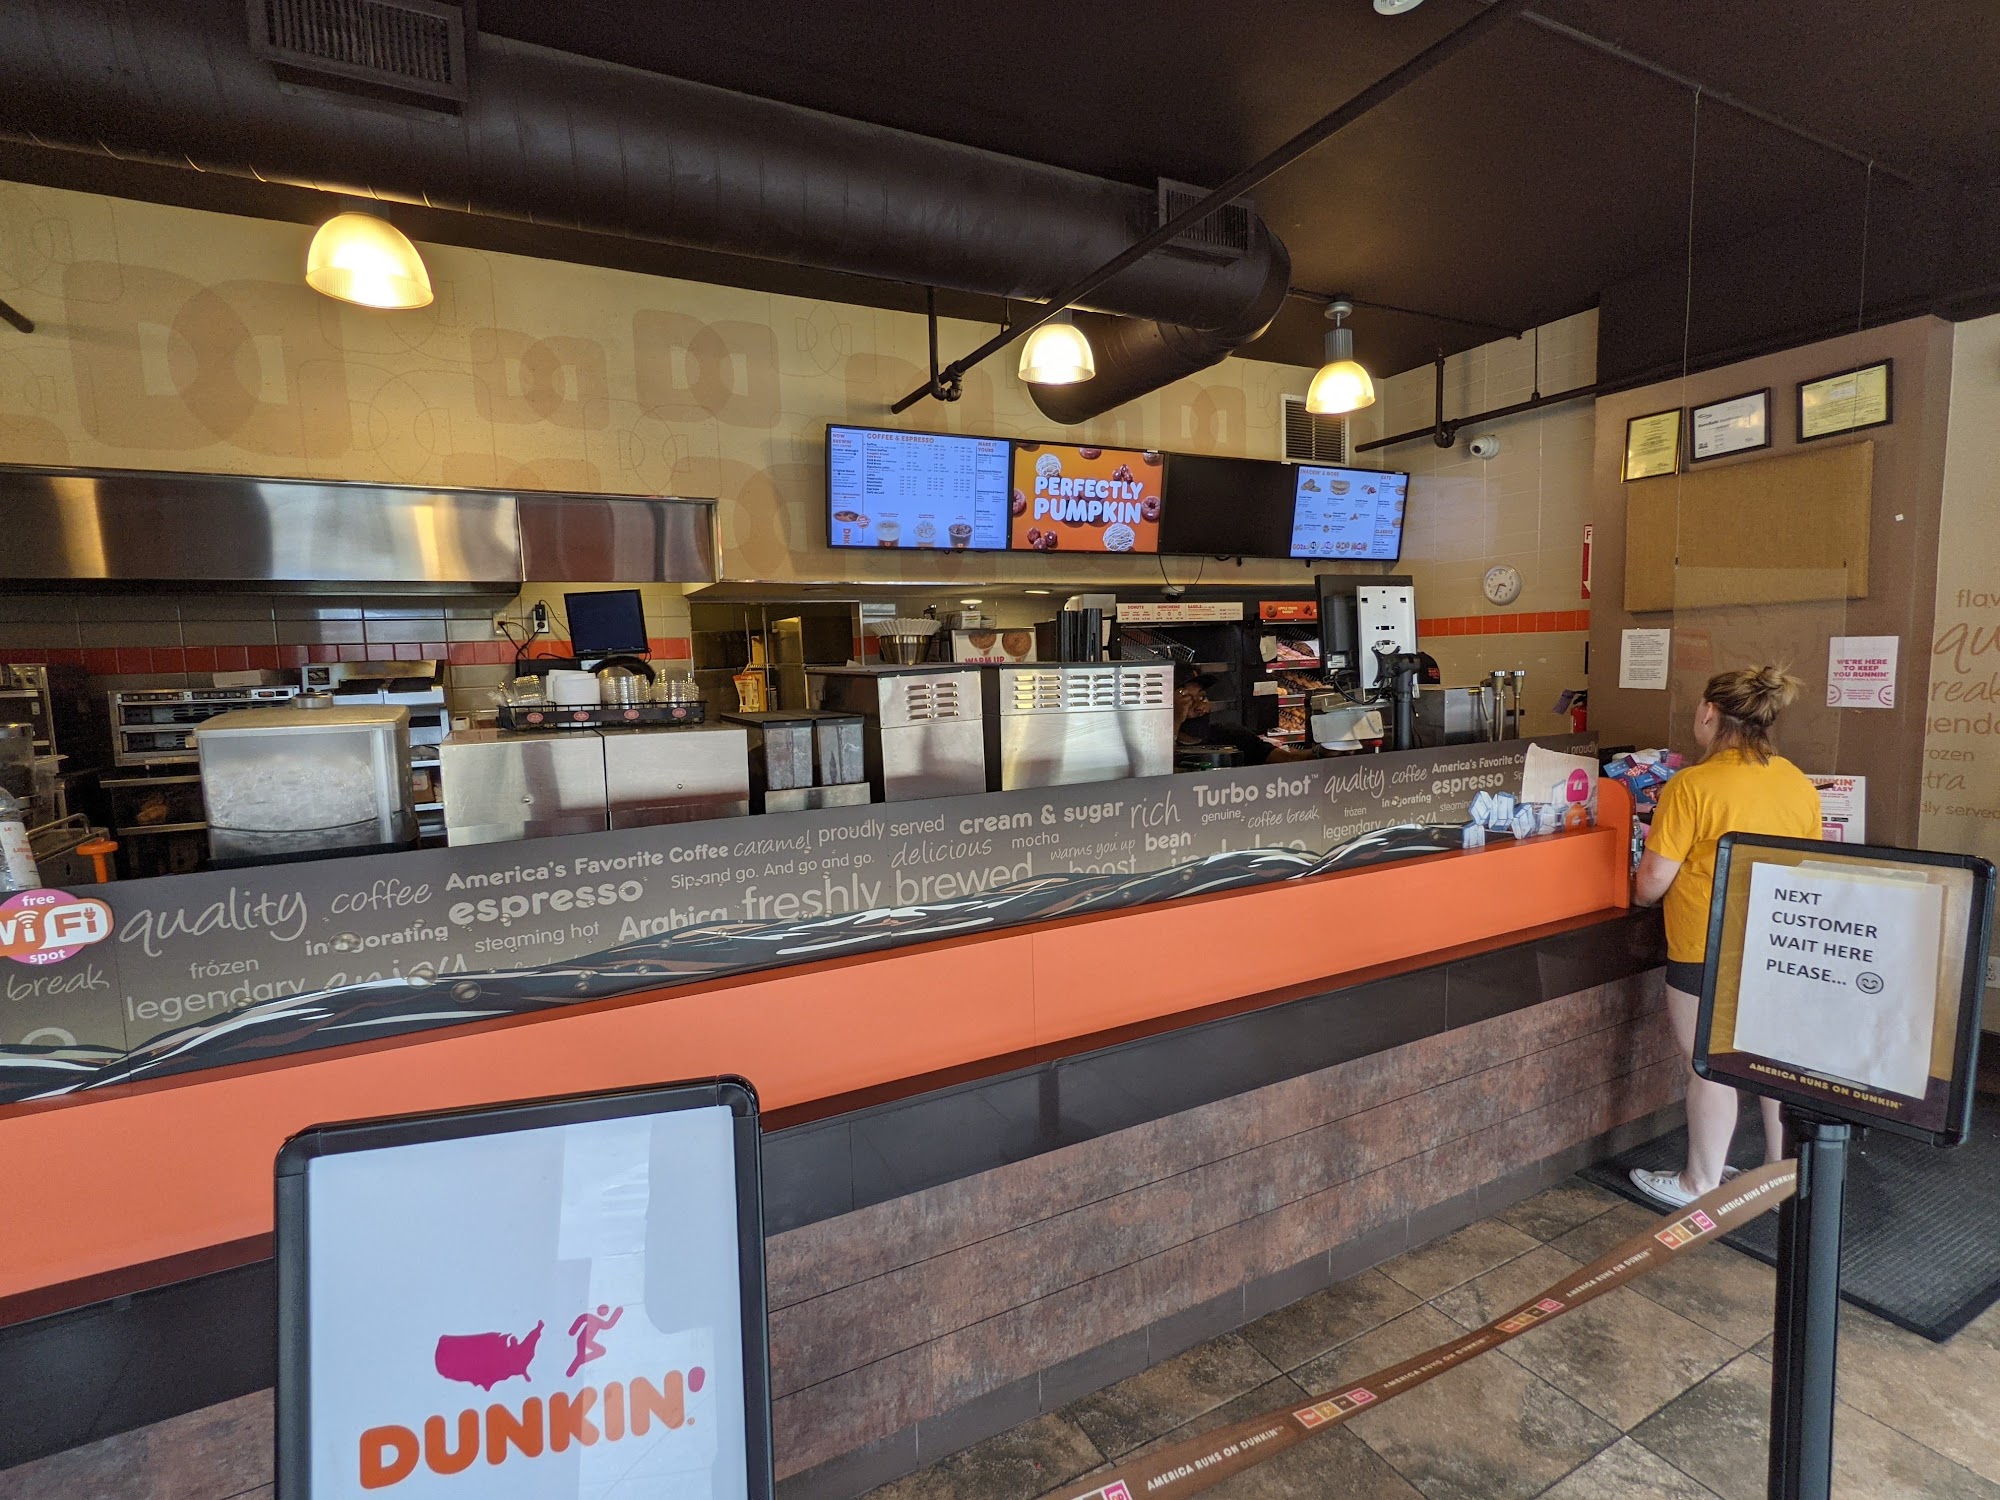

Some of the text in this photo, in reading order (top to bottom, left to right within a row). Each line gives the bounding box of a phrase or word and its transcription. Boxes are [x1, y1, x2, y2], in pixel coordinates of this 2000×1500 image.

[866, 433, 894, 441] COFFEE
[901, 435, 935, 444] ESPRESSO
[1035, 476, 1144, 500] PERFECTLY
[1034, 497, 1141, 524] PUMPKIN
[1391, 764, 1428, 784] coffee
[1431, 753, 1526, 774] America's Favorite Co
[1193, 782, 1258, 808] Turbo
[1324, 765, 1384, 798] quality
[1431, 773, 1504, 795] espresso
[1130, 790, 1181, 828] rich
[1344, 806, 1367, 818] frozen
[1381, 794, 1432, 808] inorating
[818, 814, 945, 847] proudly served
[959, 801, 1124, 835] cream & sugar
[1201, 808, 1241, 826] genuine
[1247, 804, 1320, 829] coffee break
[1323, 815, 1382, 841] legendary
[733, 830, 810, 856] caramel
[891, 838, 993, 869] delicious
[1011, 832, 1060, 849] mocha
[1050, 838, 1136, 861] warms you up
[1145, 831, 1192, 852] bean
[446, 843, 729, 891] America's Favorite Coffee
[702, 868, 731, 885] and
[735, 865, 760, 883] go.
[764, 860, 795, 877] And
[798, 859, 818, 876] go
[821, 853, 850, 869] and
[853, 852, 875, 868] go.
[1069, 854, 1137, 874] boost
[22, 895, 55, 907] free
[331, 879, 432, 914] coffee
[742, 852, 1033, 922] freshly brewed
[1774, 888, 1822, 906] NEXT
[449, 880, 644, 927] espresso
[119, 887, 308, 957] quality
[618, 905, 728, 942] Arabica
[1771, 911, 1878, 939] CUSTOMER
[305, 925, 449, 956] inorating
[474, 920, 600, 954] steaming hot
[1769, 933, 1874, 963] WAIT HERE
[29, 949, 66, 965] spot
[190, 957, 260, 980] frozen
[7, 963, 110, 1001] break
[1766, 958, 1847, 986] PLEASE...
[126, 977, 306, 1022] legendary
[1749, 1062, 1904, 1110] AMERICA RUNS ON DUNKIN'
[1716, 1197, 1746, 1217] AMERICA
[1744, 1187, 1761, 1201] RUNS
[1760, 1183, 1770, 1193] ON
[1566, 1279, 1597, 1298] AMERICA
[1595, 1269, 1616, 1283] RUNS
[1613, 1262, 1626, 1273] ON
[1384, 1369, 1421, 1389] AMERICA
[1420, 1358, 1444, 1373] RUNS
[1442, 1352, 1456, 1361] ON
[359, 1365, 706, 1490] DUNKIN'
[1147, 1464, 1195, 1491] AMERICA
[1195, 1451, 1223, 1471] RUNS
[1223, 1444, 1240, 1457] ON
